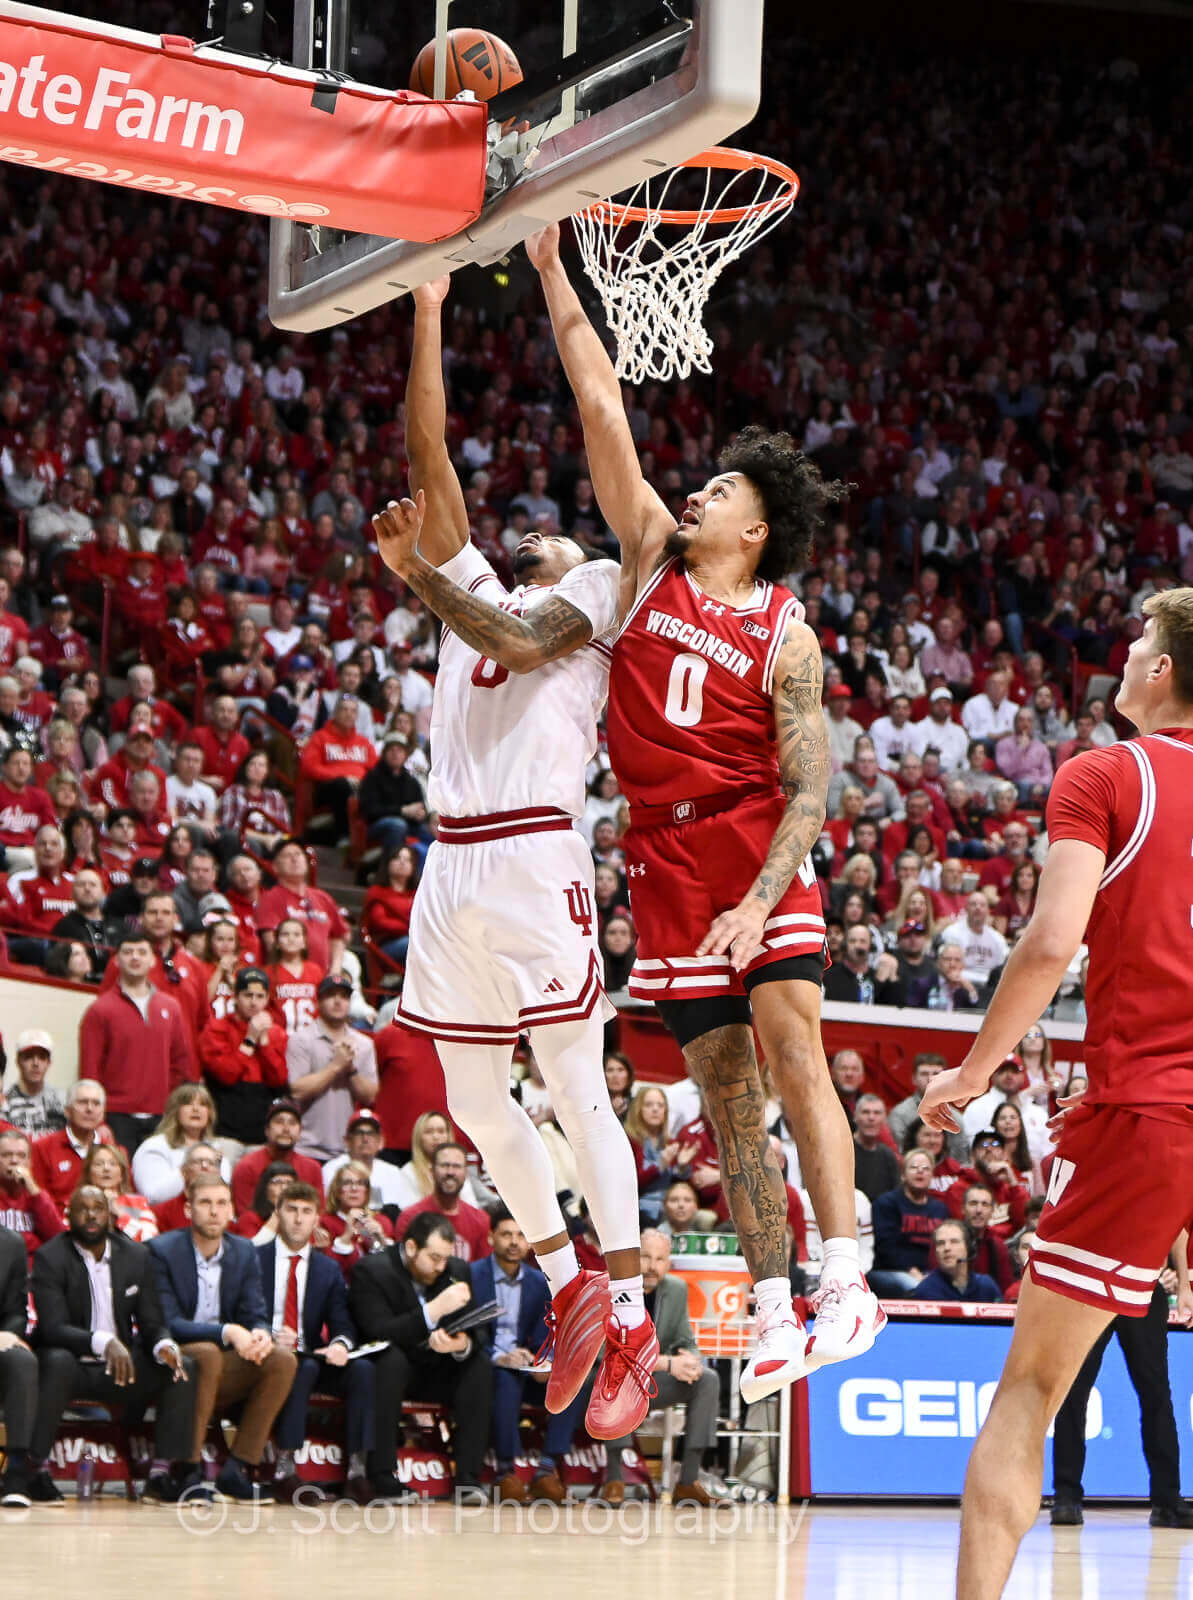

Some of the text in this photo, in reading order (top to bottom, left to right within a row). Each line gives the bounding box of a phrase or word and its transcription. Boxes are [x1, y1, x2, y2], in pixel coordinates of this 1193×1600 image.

[646, 609, 754, 679] WISCONSIN
[664, 652, 709, 727] 0
[839, 1377, 1104, 1440] GEI
